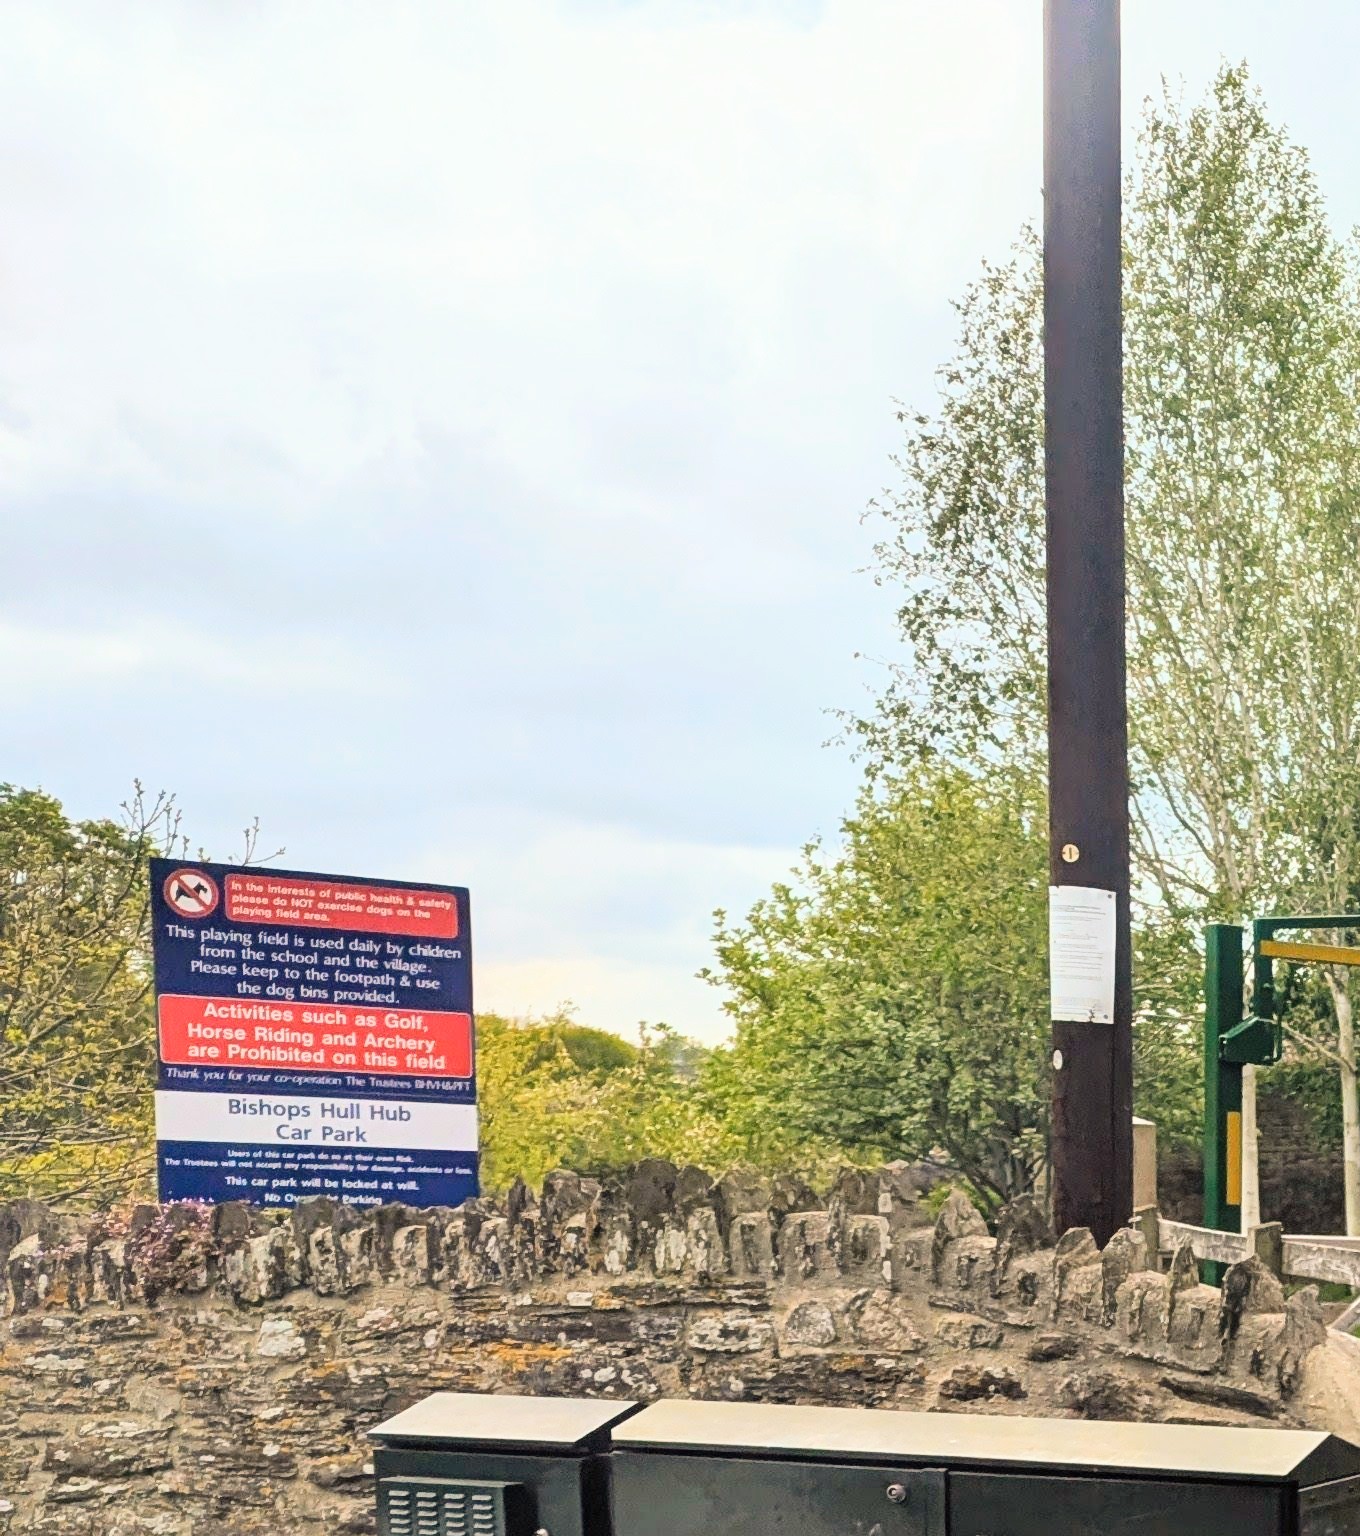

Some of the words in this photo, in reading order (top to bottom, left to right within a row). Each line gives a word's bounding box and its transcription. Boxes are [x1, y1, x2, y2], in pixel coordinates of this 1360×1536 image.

[231, 881, 242, 891] In
[246, 883, 264, 892] the
[268, 884, 315, 897] interests
[319, 888, 331, 898] of
[335, 892, 366, 901] public
[370, 893, 403, 905] health
[419, 899, 451, 910] safety
[232, 894, 269, 905] please
[273, 897, 287, 906] do
[291, 898, 314, 908] NOT
[317, 902, 363, 912] exercise
[366, 905, 393, 916] dogs
[397, 909, 411, 917] on
[414, 909, 431, 918] the
[232, 906, 272, 918] playing
[276, 908, 300, 919] field
[304, 912, 330, 922] area.
[165, 924, 195, 939] This
[201, 927, 252, 946] playing
[258, 931, 289, 946] field
[294, 934, 305, 947] is
[310, 937, 344, 950] used
[349, 938, 381, 955] daily
[387, 942, 405, 957] by
[409, 943, 461, 959] children
[200, 944, 235, 959] from
[241, 948, 265, 961] the
[271, 950, 318, 964] school
[324, 954, 350, 966] and
[356, 957, 378, 969] the
[384, 959, 432, 975] village.
[190, 960, 237, 975] Please
[242, 963, 278, 980] keep
[284, 969, 300, 979] to
[305, 970, 329, 982] the
[335, 970, 395, 987] footpath
[400, 975, 411, 987] &
[416, 978, 441, 989] use
[237, 981, 261, 995] the
[266, 982, 294, 1000] dog
[300, 985, 329, 998] bins
[334, 989, 400, 1004] provided.
[204, 1002, 293, 1022] Activities
[302, 1010, 347, 1025] such
[355, 1014, 377, 1027] as
[385, 1013, 429, 1032] Golf,
[187, 1023, 246, 1041] Horse
[254, 1026, 314, 1047] Riding
[322, 1032, 357, 1046] and
[364, 1033, 435, 1054] Archery
[188, 1046, 220, 1058] are
[227, 1044, 325, 1064] Prohibited
[332, 1052, 357, 1065] on
[364, 1051, 397, 1067] this
[405, 1054, 446, 1070] field
[166, 1068, 199, 1079] Thank
[203, 1071, 225, 1081] you
[228, 1070, 243, 1080] for
[247, 1073, 272, 1083] your
[274, 1074, 341, 1086] co-operation
[345, 1076, 366, 1086] The
[369, 1077, 412, 1089] Trustees
[228, 1098, 311, 1121] Bishops
[320, 1102, 361, 1120] Hull
[369, 1104, 412, 1122] Hub
[276, 1124, 312, 1141] Car
[322, 1126, 368, 1143] Park
[164, 1158, 180, 1166] The
[183, 1158, 218, 1167] Trustees
[221, 1159, 236, 1167] will
[256, 1161, 282, 1169] accept
[284, 1162, 299, 1170] any
[227, 1149, 250, 1158] Users
[252, 1150, 262, 1158] of
[264, 1150, 280, 1158] this
[297, 1152, 315, 1160] park
[317, 1152, 329, 1160] do
[225, 1176, 248, 1186] This
[251, 1178, 268, 1186] car
[272, 1177, 297, 1188] park
[302, 1178, 321, 1188] will
[325, 1179, 339, 1188] be
[342, 1179, 378, 1189] locked
[381, 1180, 393, 1190] at
[397, 1180, 420, 1191] will.
[264, 1193, 281, 1203] No
[342, 1194, 383, 1206] Parking
